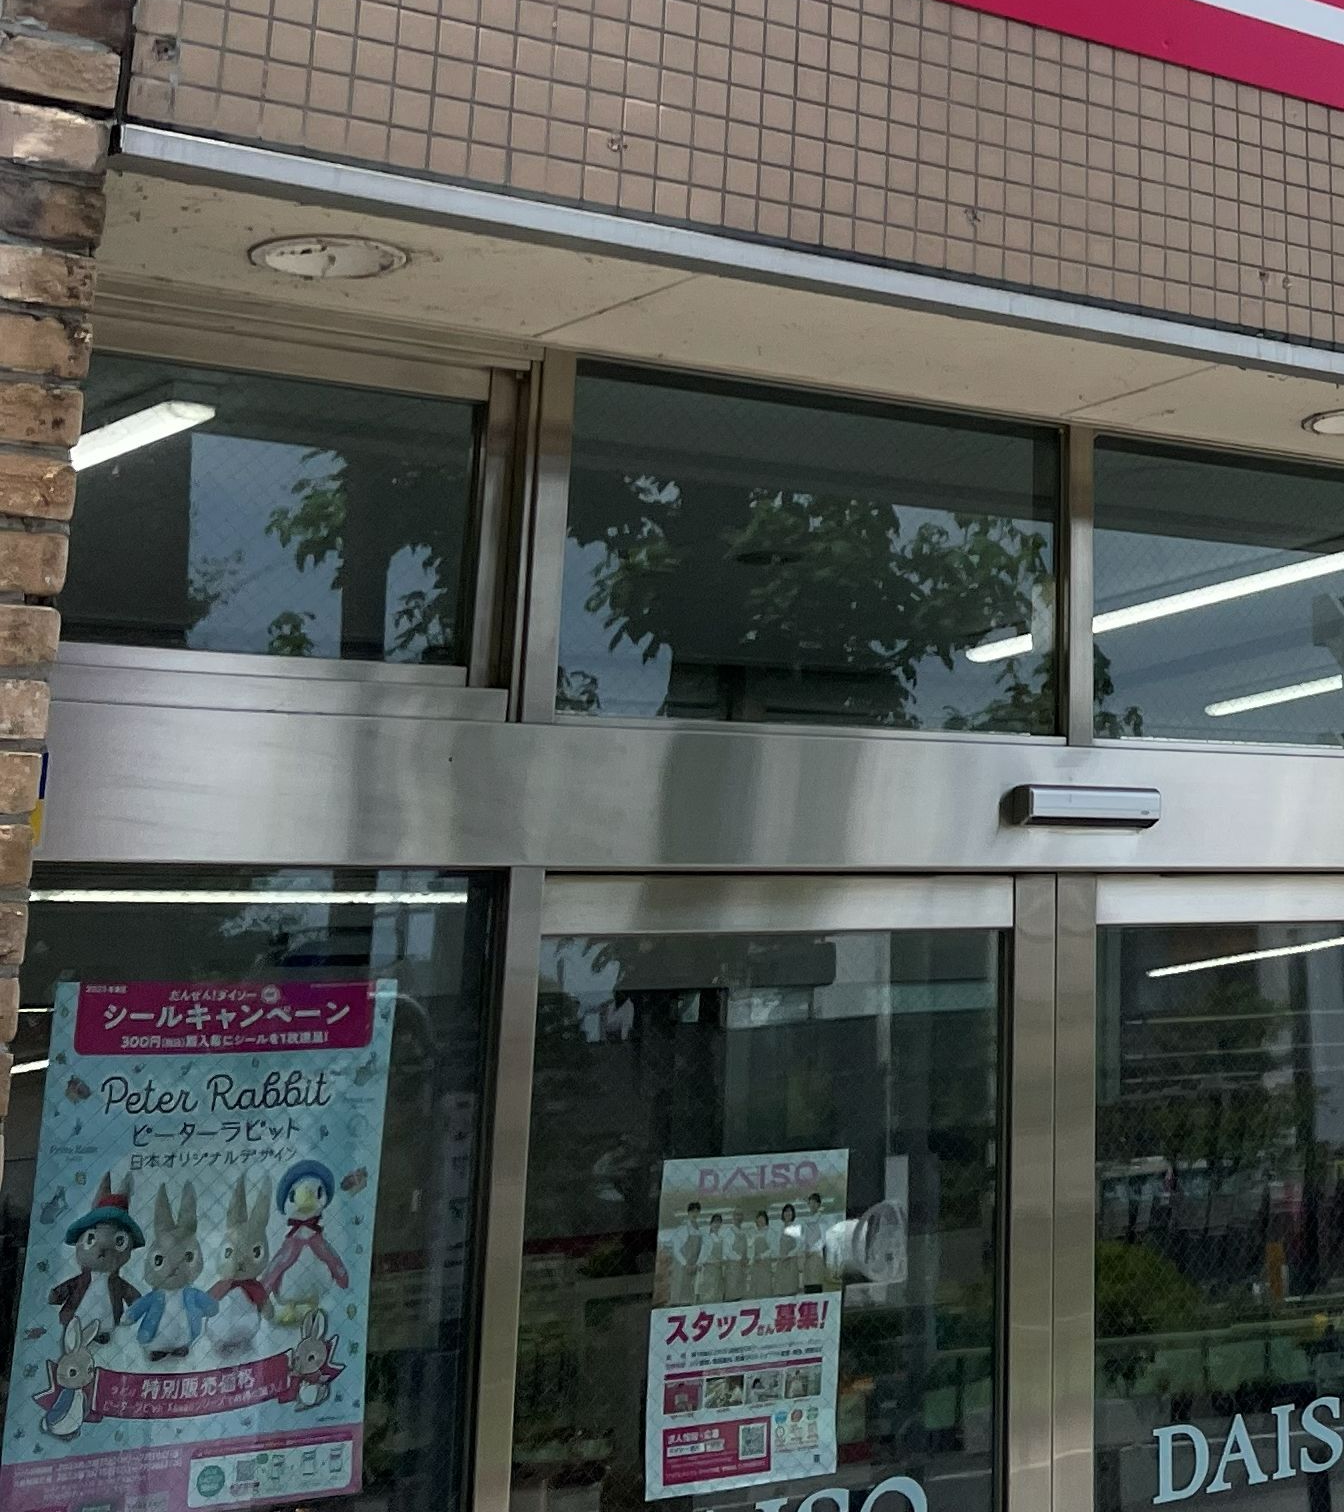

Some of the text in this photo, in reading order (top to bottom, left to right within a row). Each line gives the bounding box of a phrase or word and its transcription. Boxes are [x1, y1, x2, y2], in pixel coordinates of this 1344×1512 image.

[103, 1001, 351, 1030] シールキャンペーン
[101, 1070, 332, 1115] Peter Rabbit
[132, 1117, 301, 1147] ピーターラビット
[129, 1148, 297, 1171] 日本オリジナルデザイン
[699, 1160, 820, 1193] DAISO
